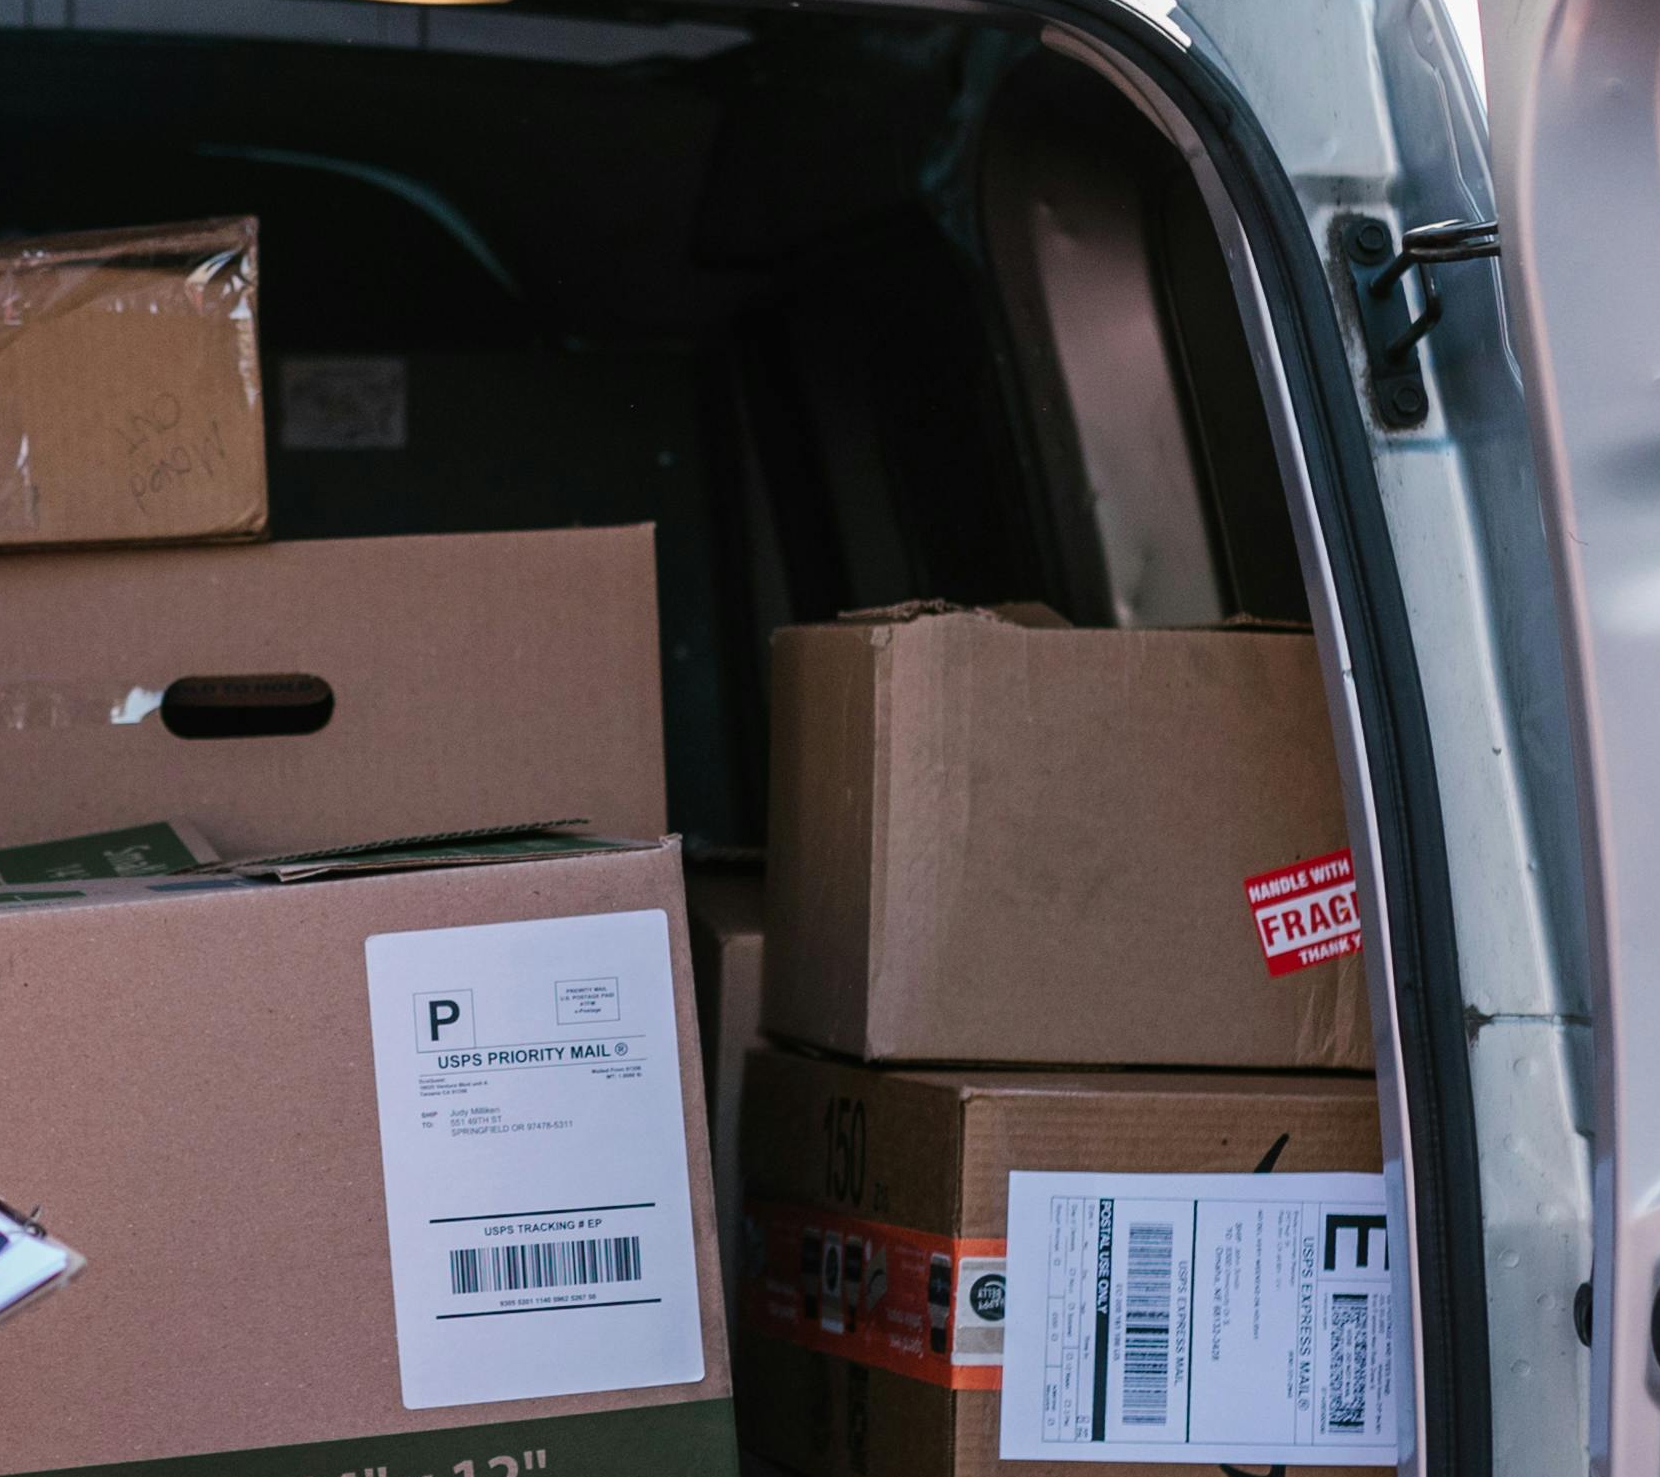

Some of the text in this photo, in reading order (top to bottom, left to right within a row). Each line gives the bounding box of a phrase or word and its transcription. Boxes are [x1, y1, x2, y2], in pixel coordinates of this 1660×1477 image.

[1248, 857, 1350, 904] HANDLE WITH
[1260, 891, 1360, 947] FRAGI
[1298, 935, 1351, 965] THANK
[428, 999, 462, 1041] P
[438, 1053, 482, 1069] USPS
[487, 1046, 564, 1065] PRIORITY
[570, 1043, 610, 1059] MAIL
[450, 1108, 468, 1117] Judy
[450, 1118, 466, 1126] 551
[491, 1115, 502, 1123] ST
[451, 1124, 509, 1136] SPRINGFIELD
[510, 1123, 525, 1132] OR
[484, 1218, 602, 1236] USPS TRACKING # EP
[1324, 1213, 1390, 1272] E
[1096, 1200, 1111, 1314] POSTAL USE ONLY
[1298, 1236, 1314, 1355] USPS EXPRESS
[1174, 1260, 1187, 1386] USPS EXPRESS MAIL
